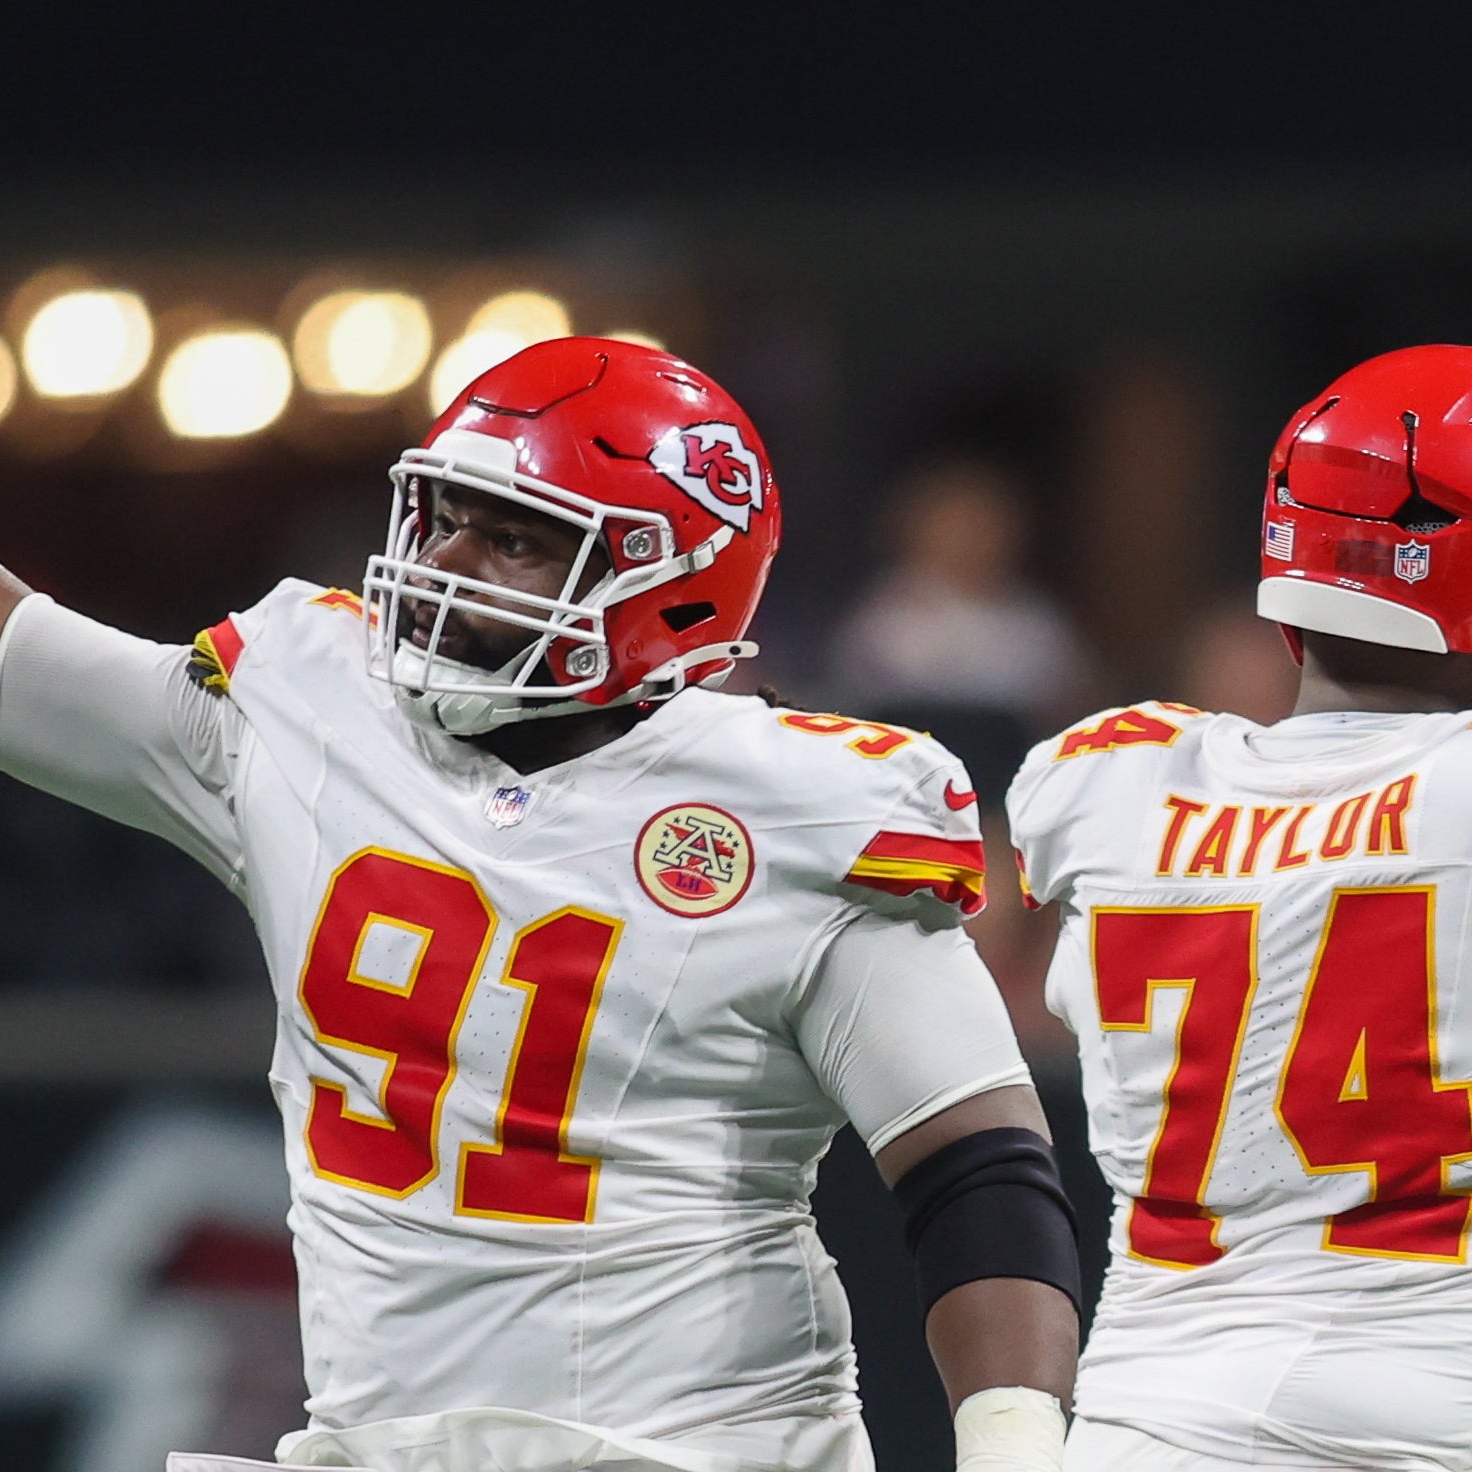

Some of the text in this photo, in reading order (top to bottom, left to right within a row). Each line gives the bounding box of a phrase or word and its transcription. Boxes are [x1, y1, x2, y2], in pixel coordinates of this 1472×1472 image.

[1399, 559, 1425, 578] NFL
[1156, 773, 1417, 878] TAYLOR
[297, 845, 626, 1225] 91
